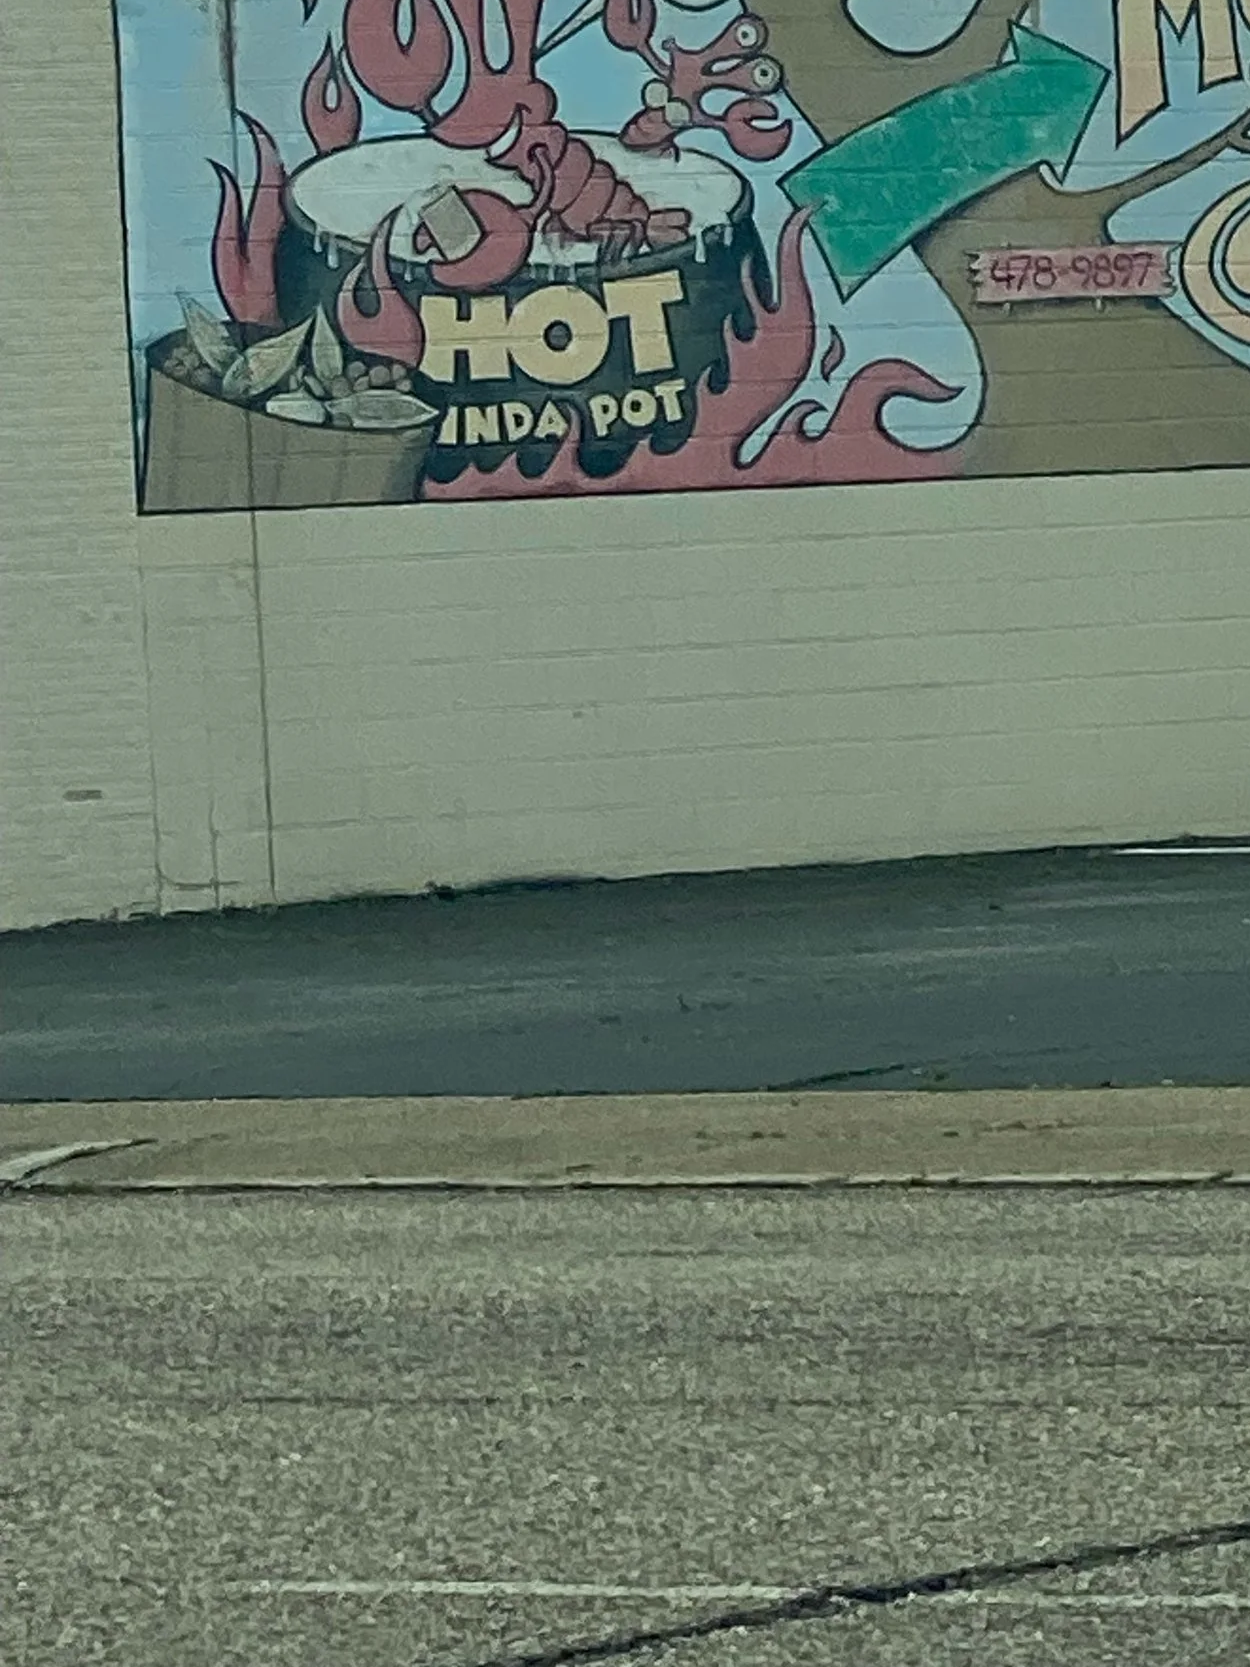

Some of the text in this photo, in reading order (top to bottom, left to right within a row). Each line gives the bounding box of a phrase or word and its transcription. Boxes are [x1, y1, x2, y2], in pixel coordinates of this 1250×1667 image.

[989, 250, 1154, 291] 478-9897
[418, 269, 685, 385] HOT
[588, 377, 687, 438] POT
